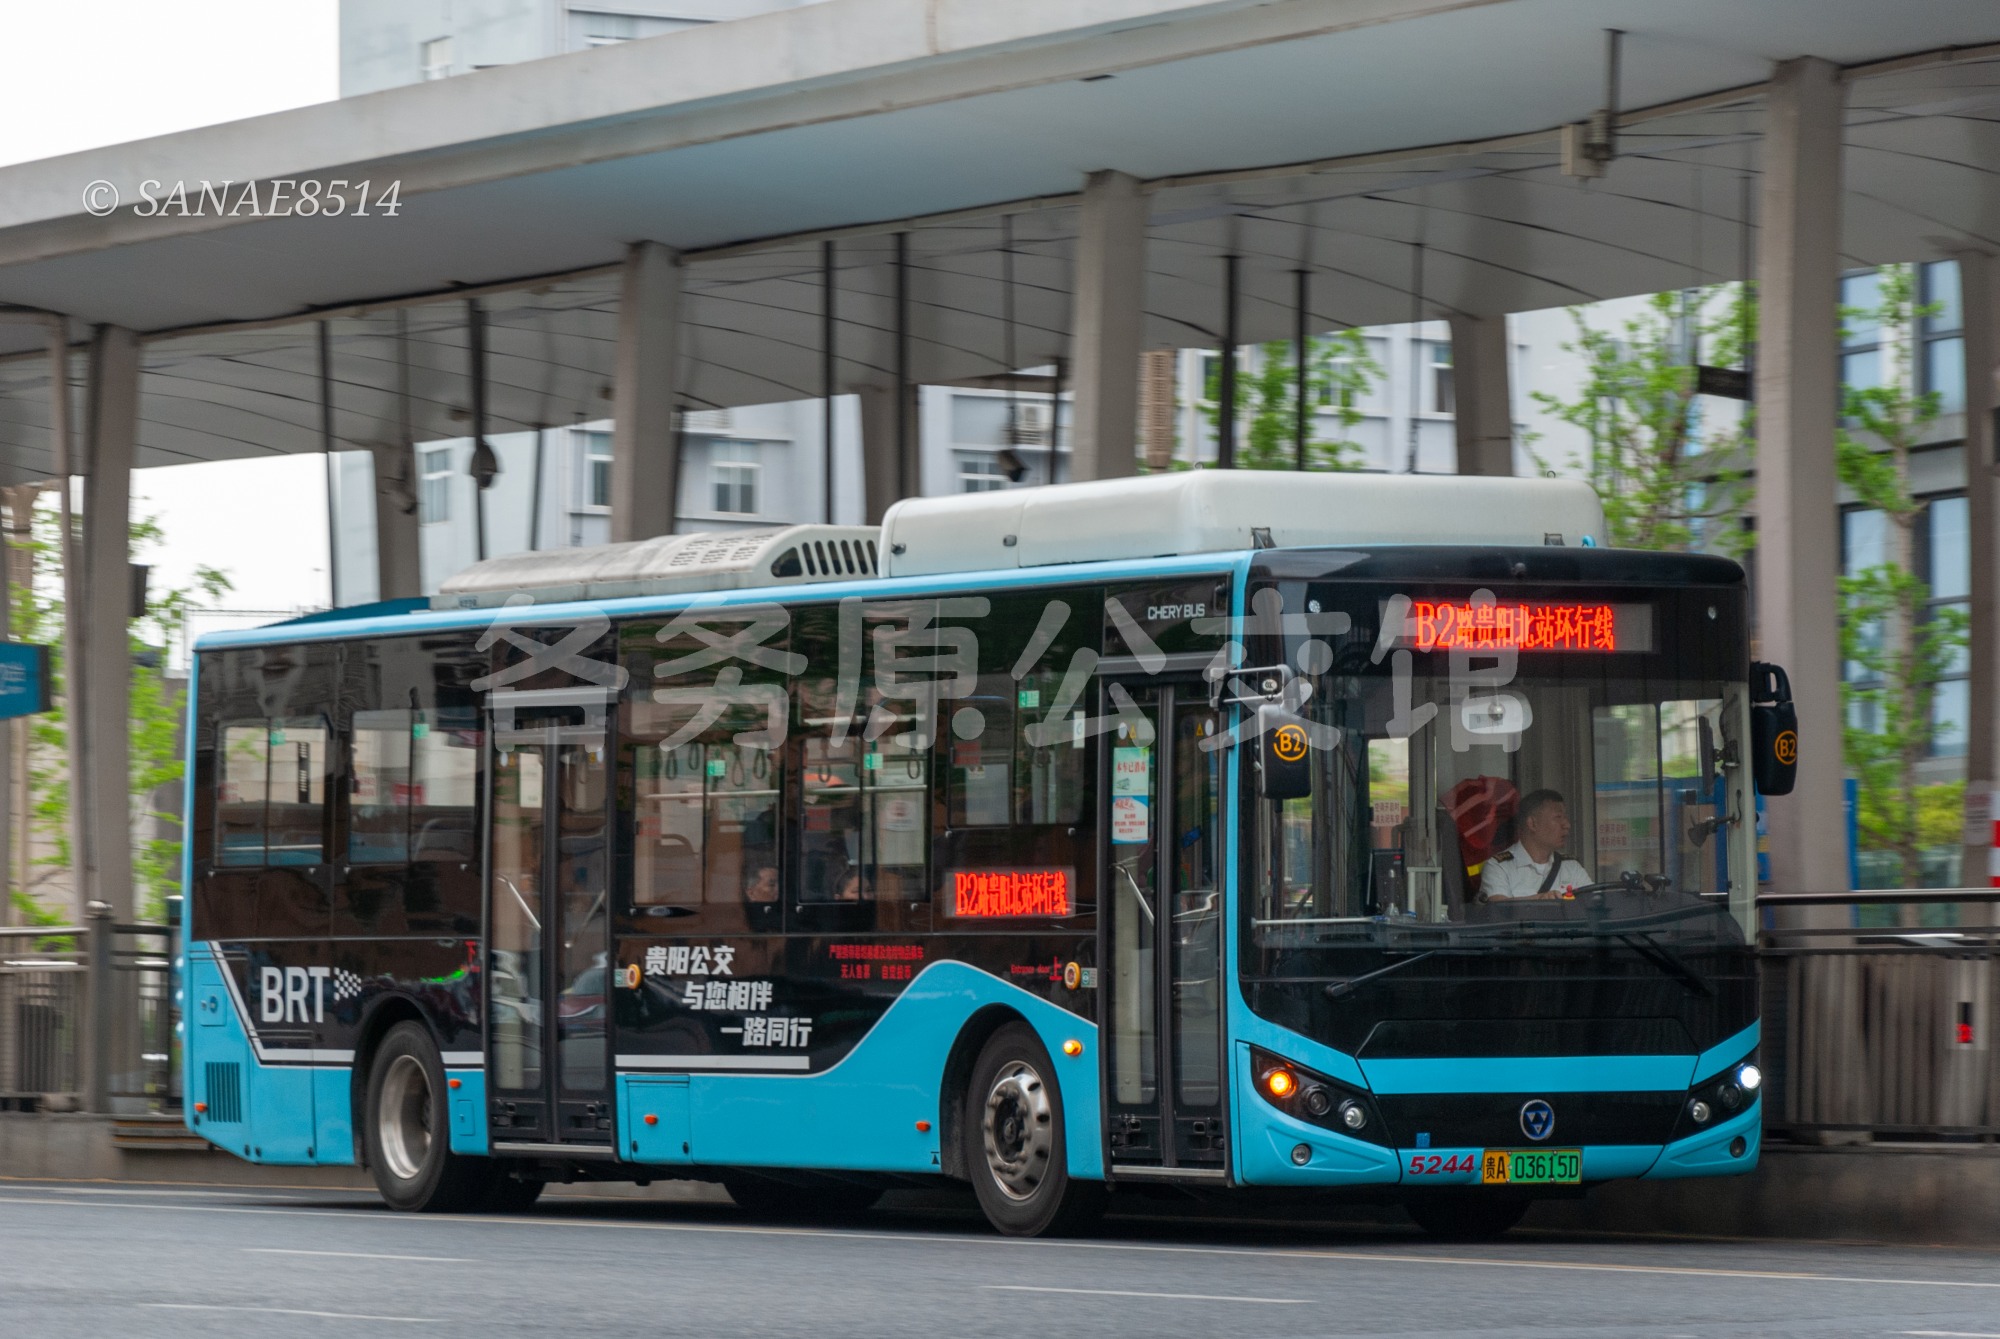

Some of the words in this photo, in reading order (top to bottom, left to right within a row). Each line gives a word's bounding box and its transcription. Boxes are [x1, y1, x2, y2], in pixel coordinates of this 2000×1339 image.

[1147, 604, 1183, 620] CHERY
[1184, 602, 1206, 618] BUS
[1415, 601, 1616, 651] B2路贵阳北站环行线
[1279, 732, 1302, 753] B2
[1779, 738, 1797, 758] B2
[955, 870, 1067, 917] B2路贵阳北站环行线
[644, 944, 736, 977] 贵阳公交
[1049, 955, 1063, 981] 上
[260, 965, 331, 1024] BRT
[681, 980, 774, 1012] 与您相伴
[719, 1016, 814, 1048] 一路同行
[1408, 1154, 1475, 1176] 5244
